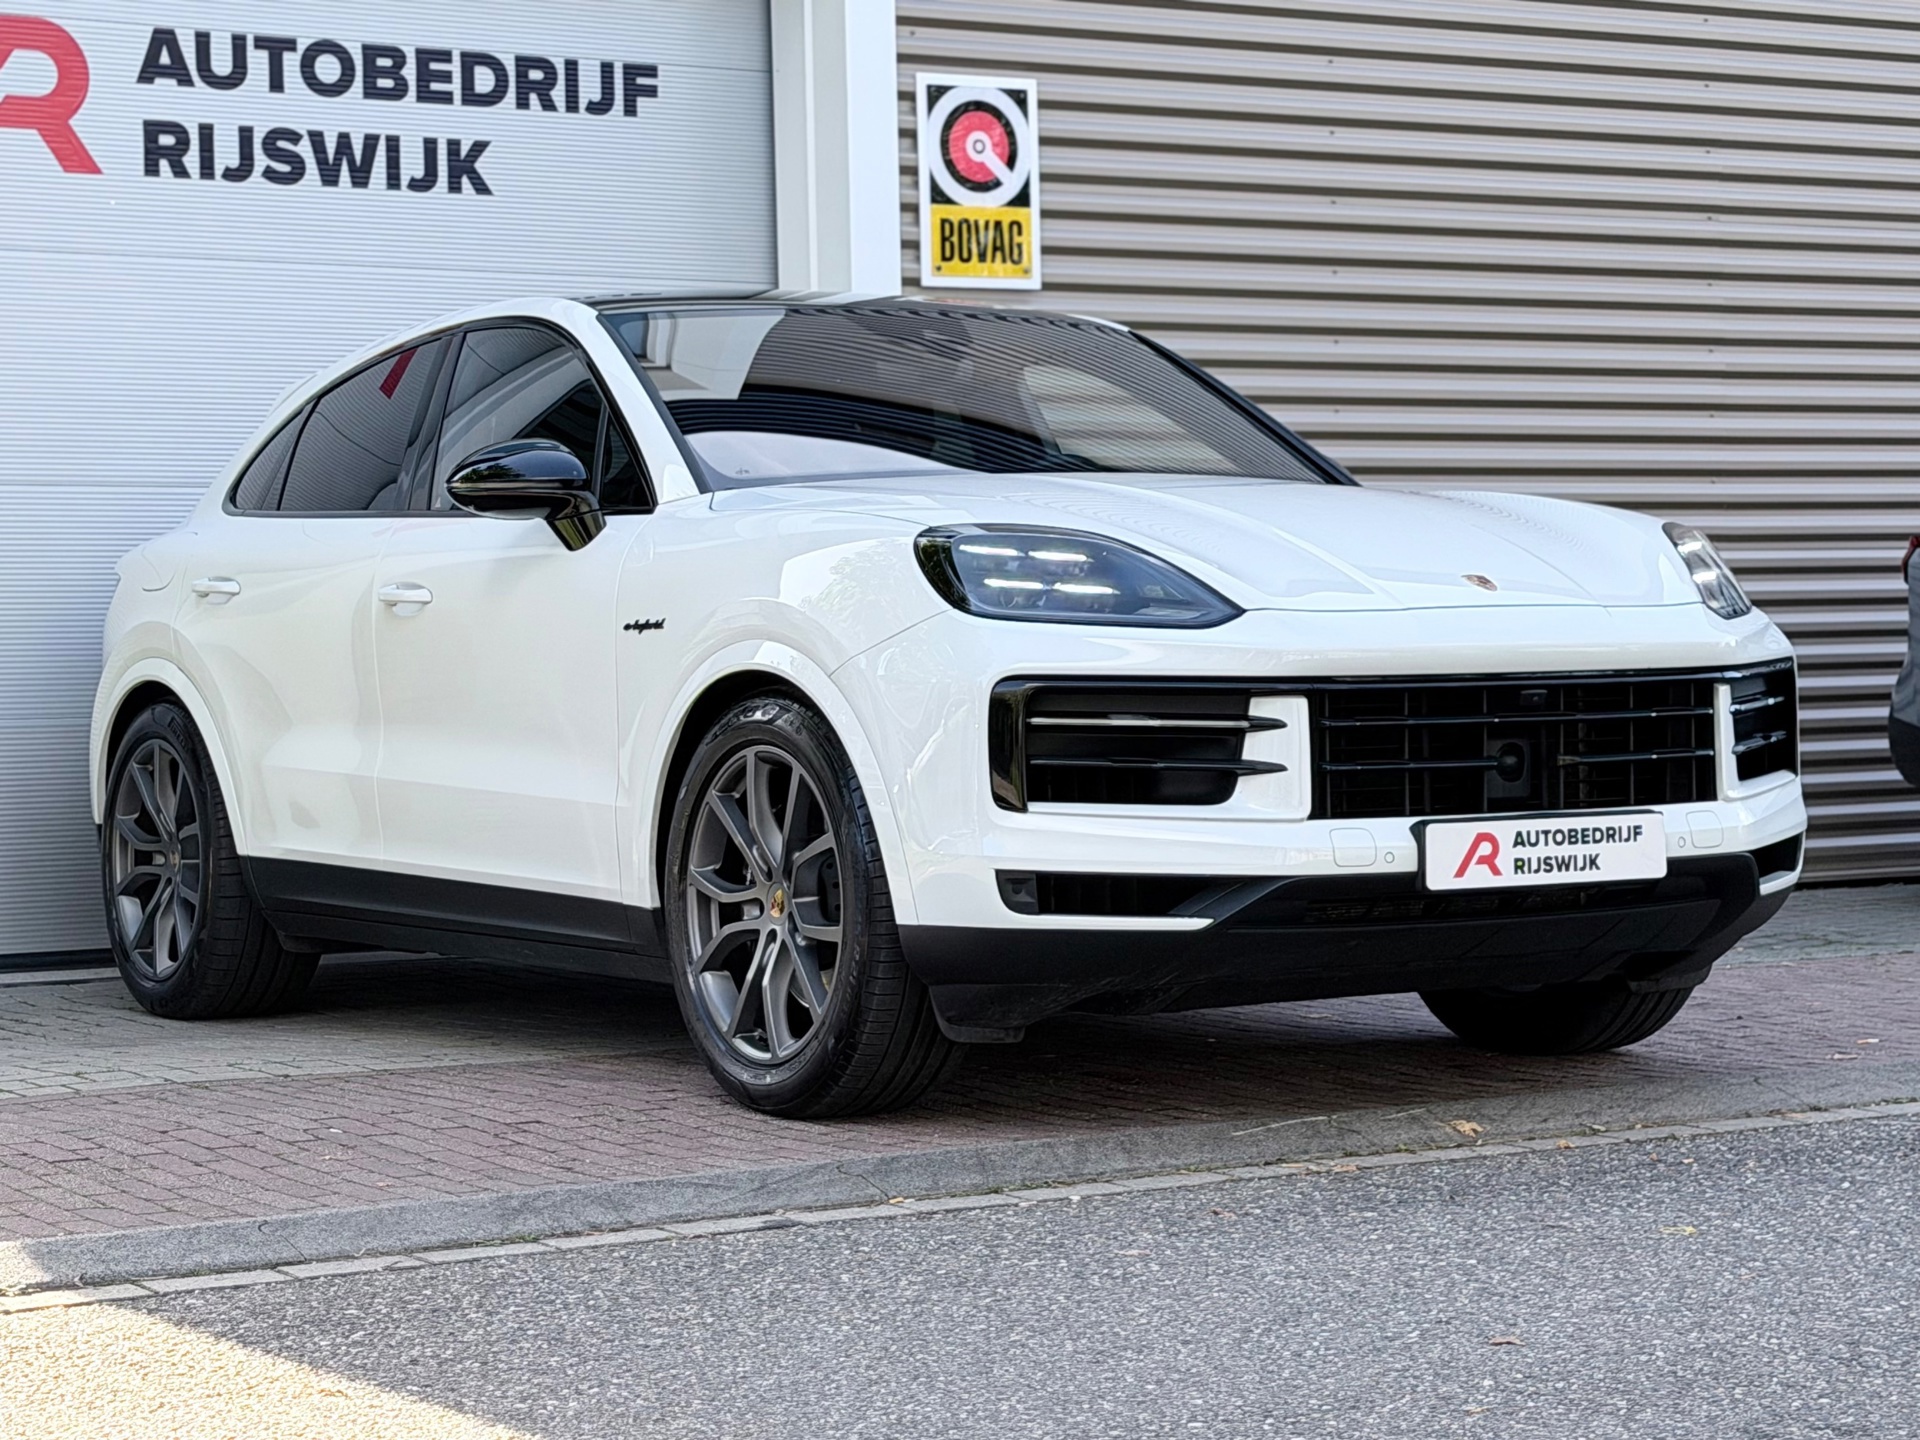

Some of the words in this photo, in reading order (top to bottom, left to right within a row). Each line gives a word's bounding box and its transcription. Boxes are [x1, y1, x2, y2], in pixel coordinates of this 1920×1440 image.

[135, 27, 659, 117] AUTOBEDRIJF
[142, 119, 495, 196] RIJSWIJK
[940, 217, 1023, 265] BOVAG
[1512, 825, 1643, 849] AUTOBEDRIJF
[1513, 853, 1601, 875] RIJSWIJK
